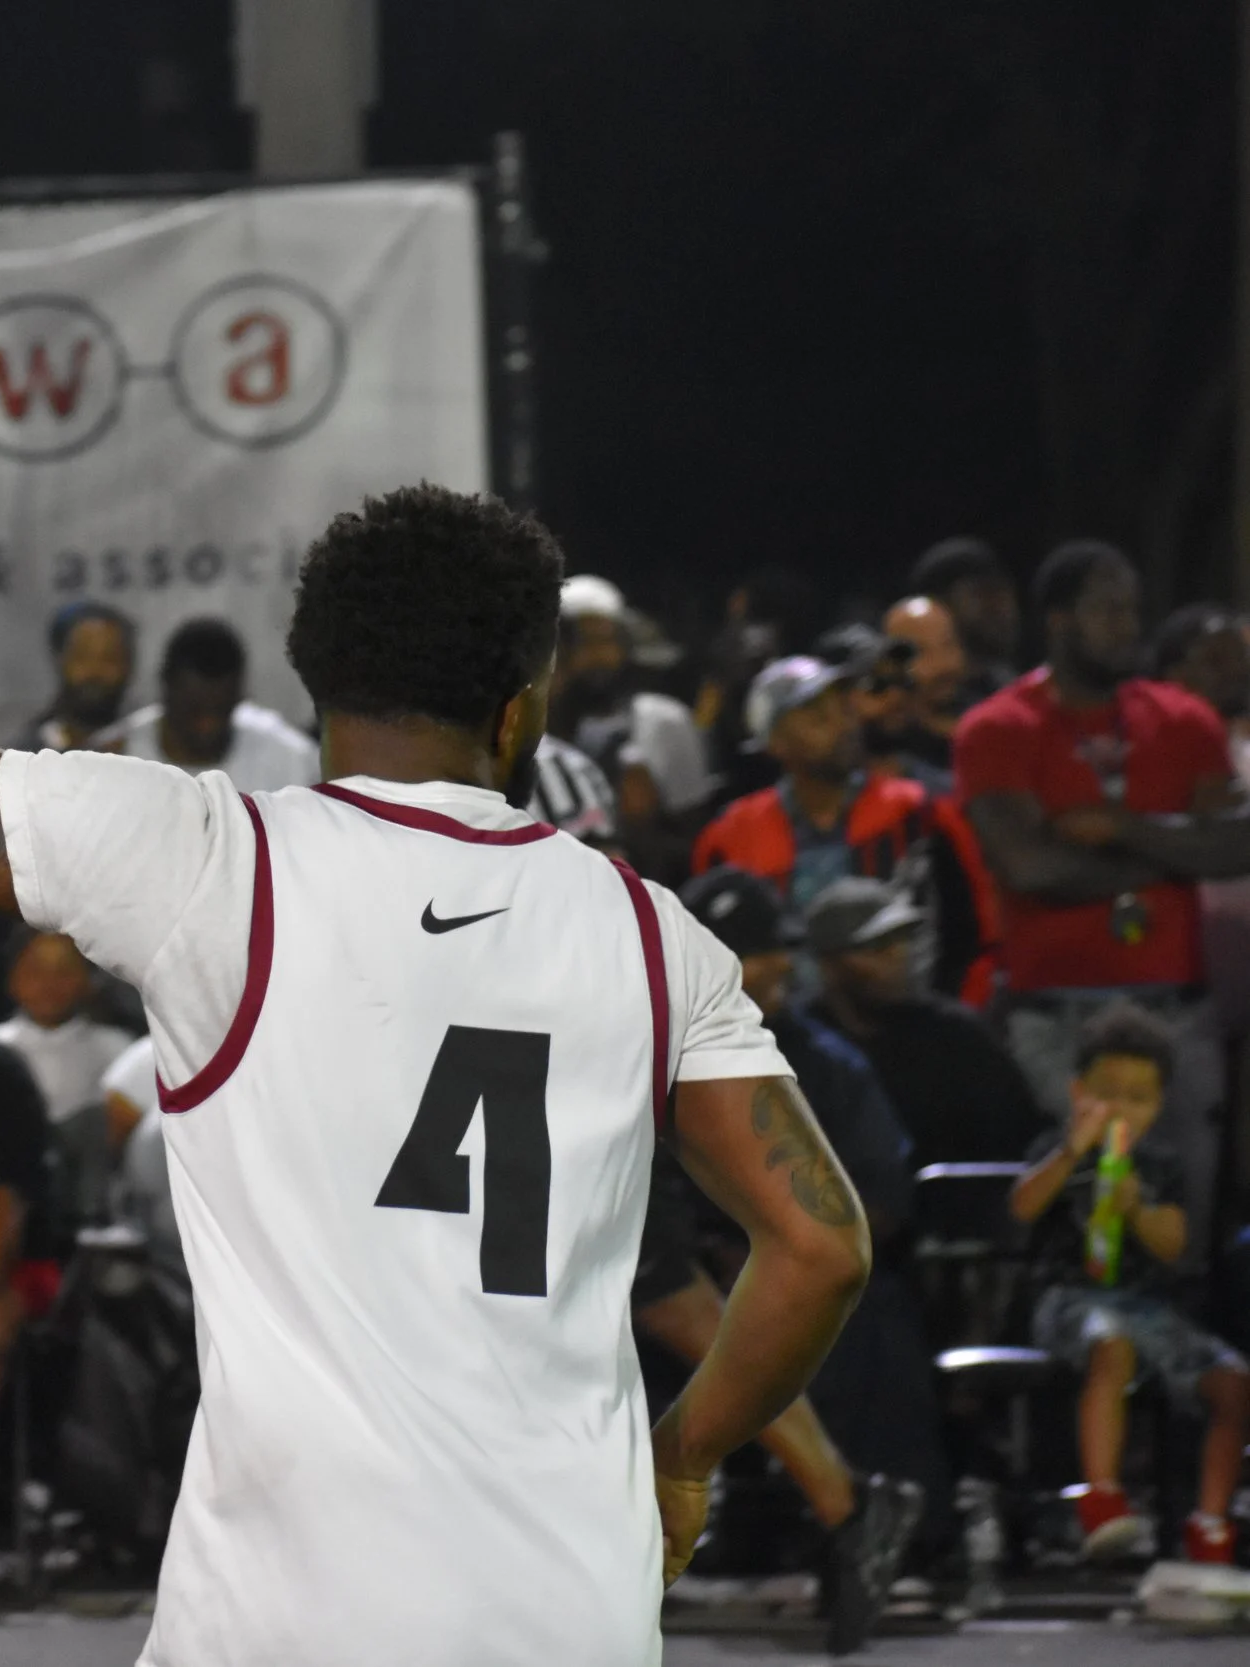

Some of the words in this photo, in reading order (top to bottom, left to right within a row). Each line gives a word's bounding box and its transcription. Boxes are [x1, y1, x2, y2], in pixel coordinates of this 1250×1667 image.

[224, 311, 291, 408] a
[53, 530, 301, 591] associ
[373, 1023, 552, 1298] 4
